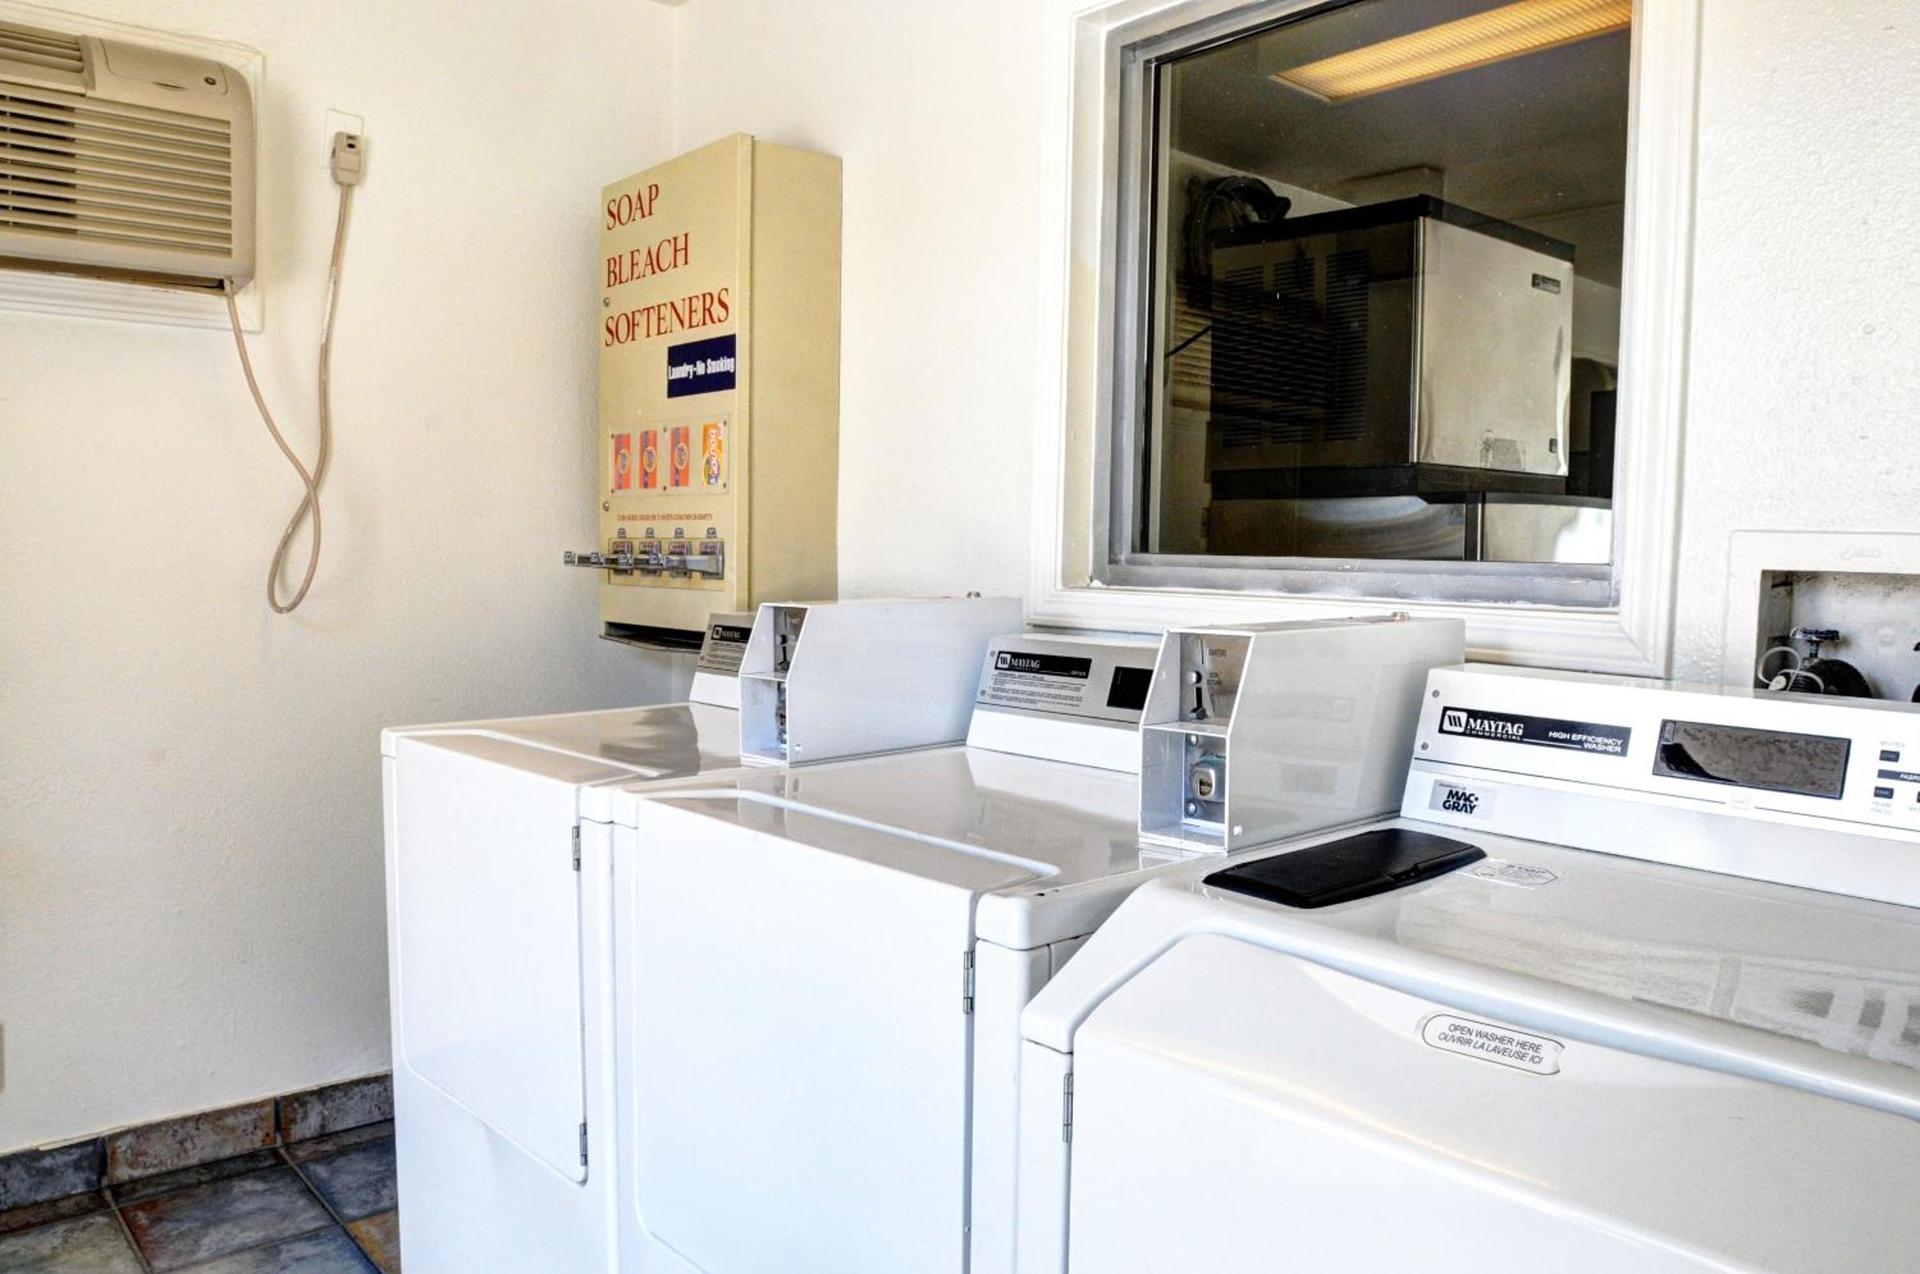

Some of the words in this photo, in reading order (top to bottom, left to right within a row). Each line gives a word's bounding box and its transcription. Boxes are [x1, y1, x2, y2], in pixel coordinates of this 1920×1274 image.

[606, 183, 660, 230] SOAP
[606, 232, 690, 288] BLEACH
[605, 288, 730, 347] SOFTENERS
[706, 356, 735, 374] Smoking
[1011, 658, 1041, 669] MAYTAG
[1465, 729, 1522, 741] COMMERCIAL
[1467, 718, 1525, 736] MAYTAG
[1548, 731, 1570, 741] HIGH
[1571, 733, 1624, 745] EFFICIENCY
[1583, 742, 1622, 753] WASHER
[1442, 800, 1477, 814] GRAY
[1448, 1023, 1473, 1037] OPEN
[1475, 1029, 1515, 1047] WASHER
[1515, 1039, 1543, 1053] HERE
[1438, 1032, 1473, 1048] OUVRIR
[1473, 1041, 1486, 1051] LA
[1486, 1043, 1528, 1062] LAVEUSE
[1528, 1054, 1544, 1065] ICI
